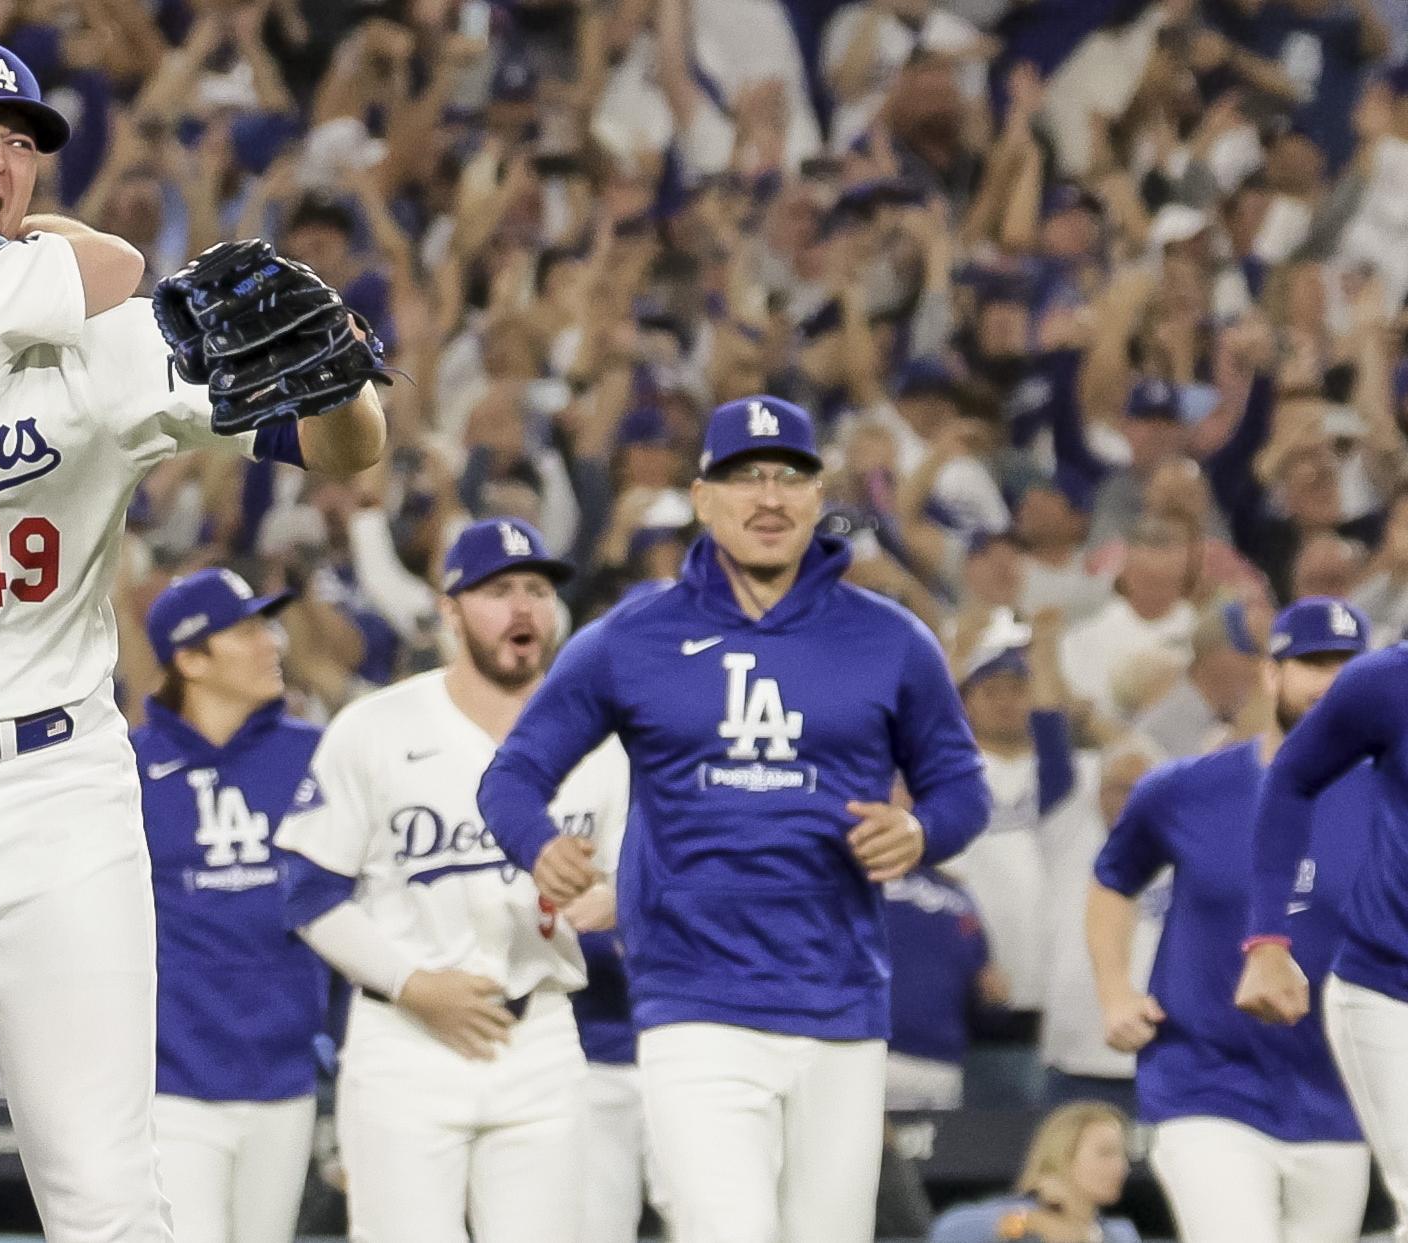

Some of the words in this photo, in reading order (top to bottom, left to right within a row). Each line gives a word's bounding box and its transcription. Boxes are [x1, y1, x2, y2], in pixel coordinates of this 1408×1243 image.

[746, 400, 781, 437] LA
[497, 521, 533, 557] LA
[718, 652, 805, 762] LA
[186, 767, 271, 868] LA
